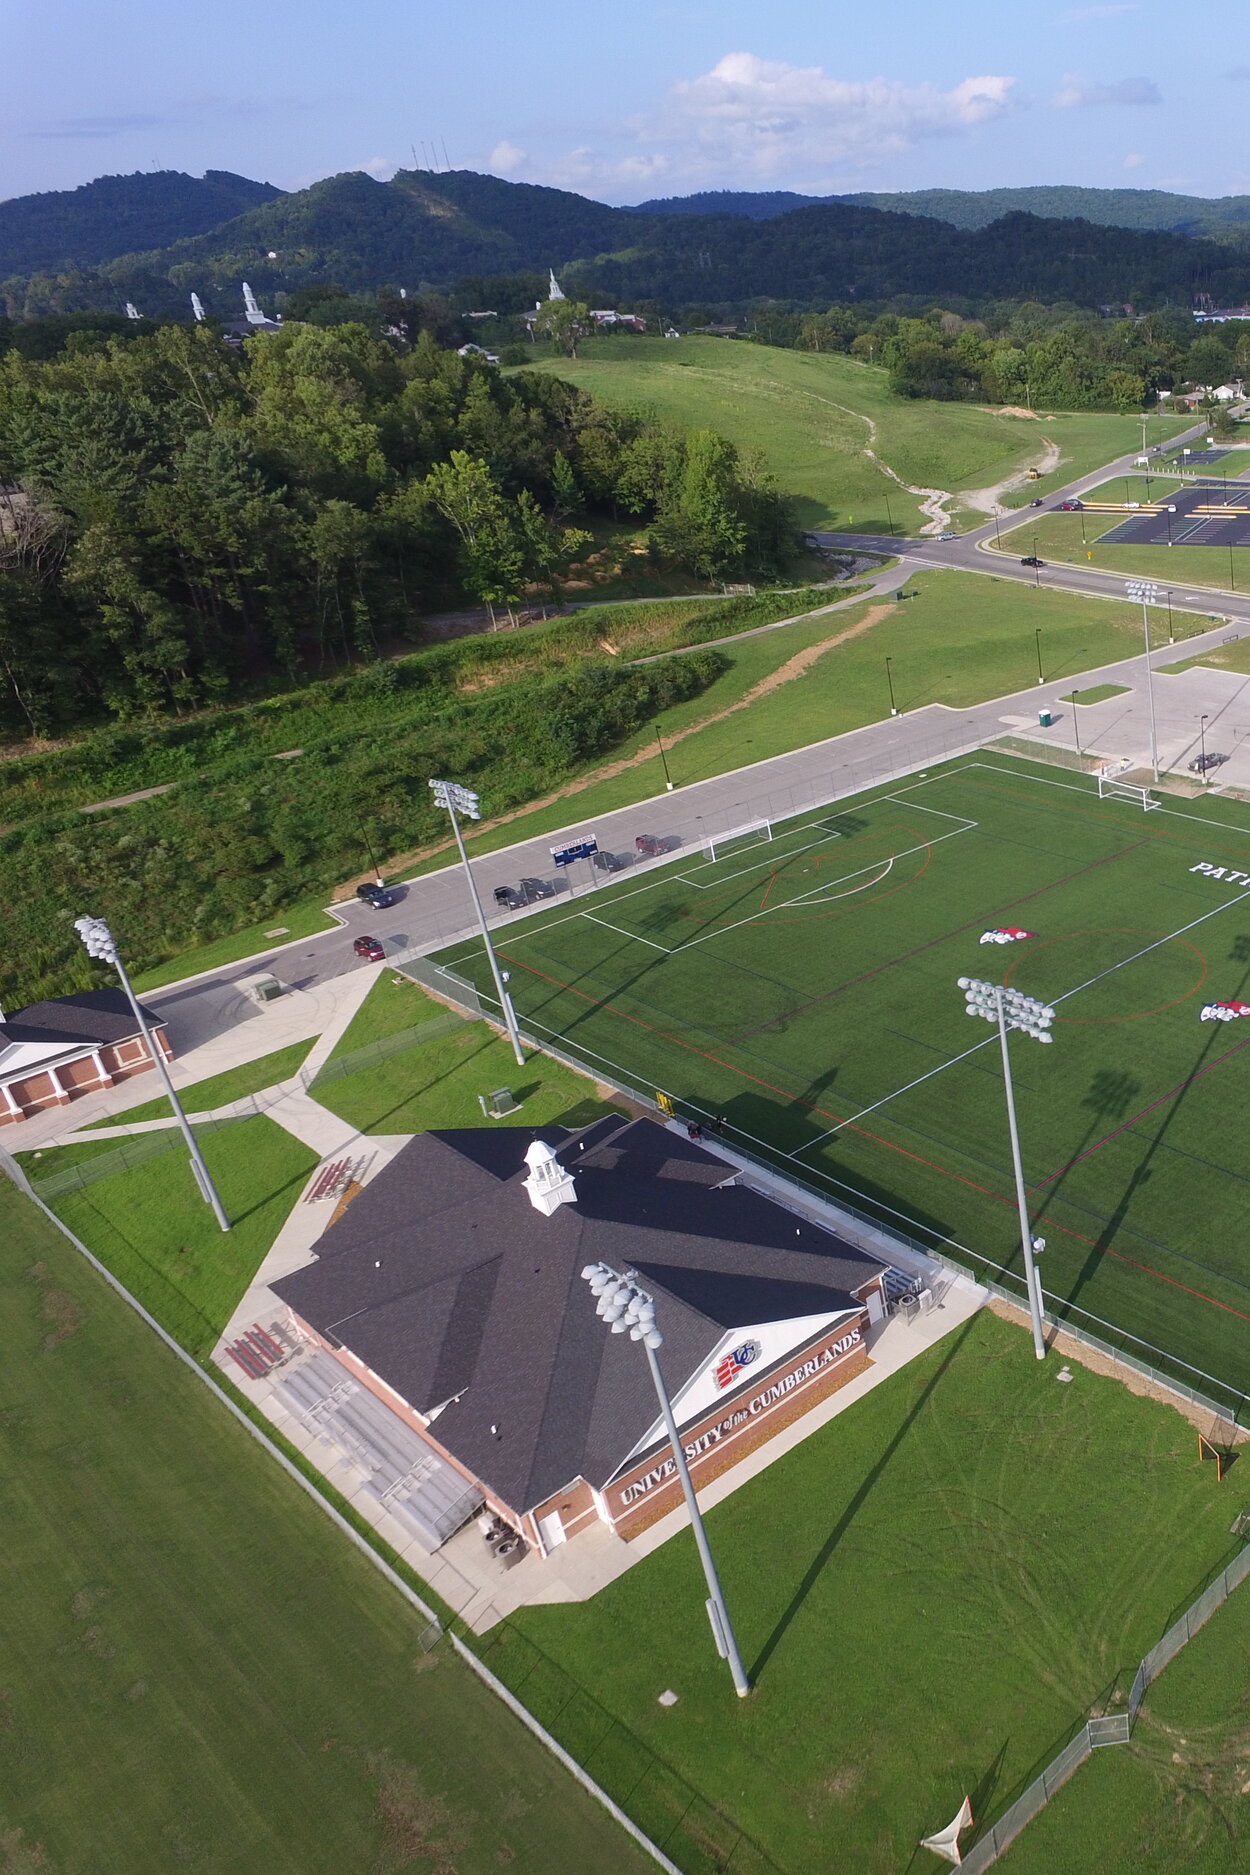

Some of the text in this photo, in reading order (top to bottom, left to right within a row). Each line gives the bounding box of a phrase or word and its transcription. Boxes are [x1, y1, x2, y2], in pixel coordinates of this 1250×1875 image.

[555, 835, 592, 851] CUMBERLANDS
[619, 1327, 861, 1506] UNIVESITY of the CUMBERLANDS
